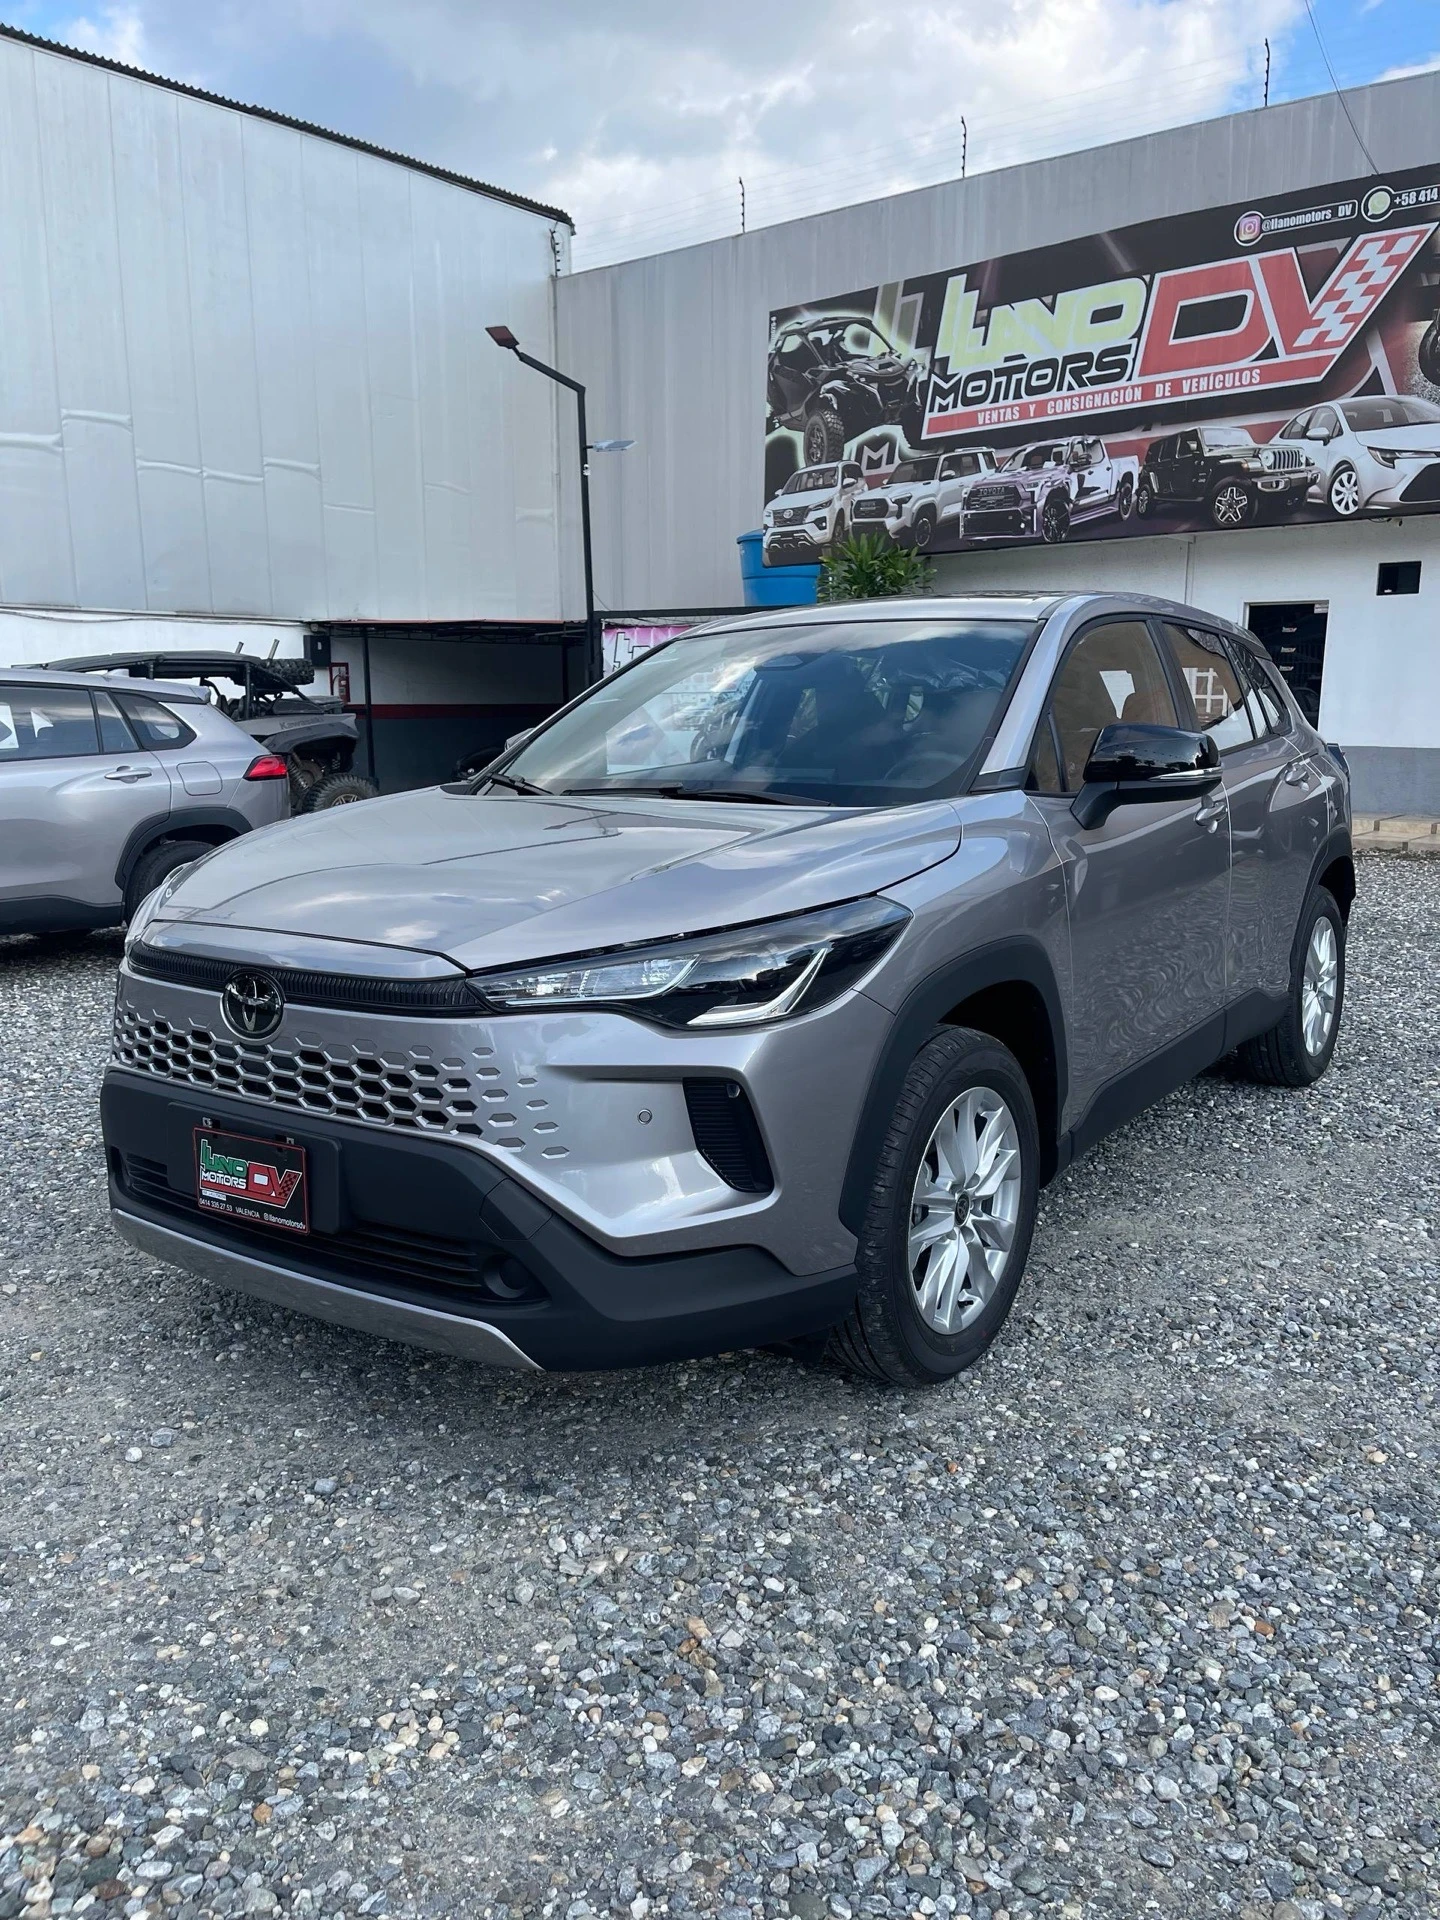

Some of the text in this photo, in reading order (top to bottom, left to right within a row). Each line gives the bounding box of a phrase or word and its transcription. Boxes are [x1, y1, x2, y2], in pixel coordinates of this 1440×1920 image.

[1394, 188, 1439, 206] +58 414
[1138, 222, 1438, 378] DV
[928, 342, 1134, 413] MOTORS
[977, 369, 1261, 425] VENTAS Y CONSIGNACIÓN DE VEHÍCULOS
[980, 487, 1005, 496] TOYOTA
[201, 1170, 247, 1189] MOTORS
[248, 1161, 302, 1201] DV
[235, 1206, 260, 1218] VALENCIA
